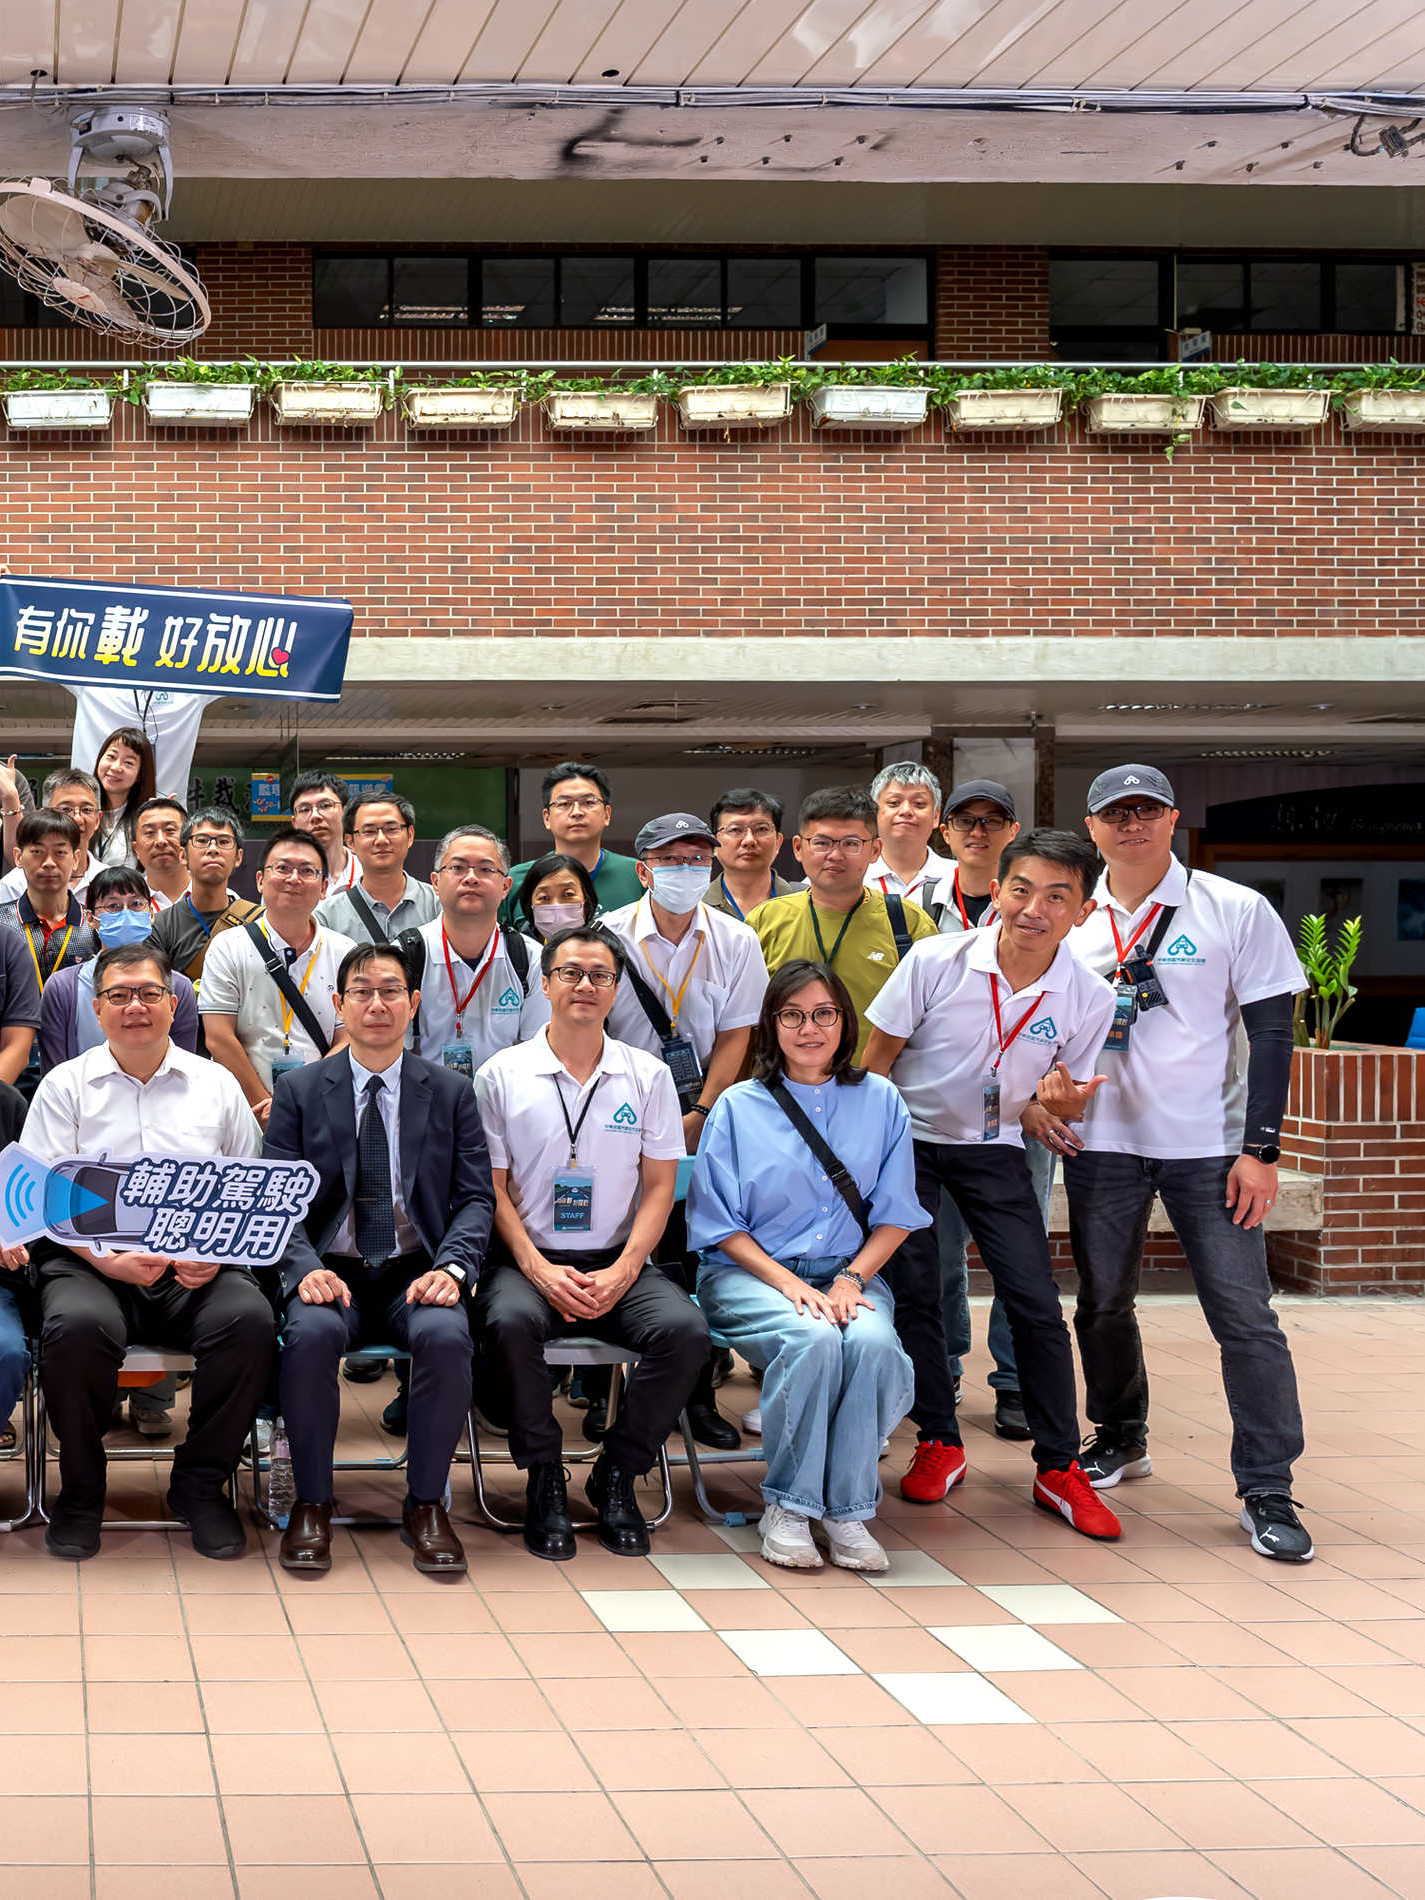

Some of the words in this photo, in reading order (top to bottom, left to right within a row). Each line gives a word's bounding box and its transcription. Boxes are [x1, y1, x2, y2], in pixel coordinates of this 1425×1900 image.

[13, 605, 145, 666] 有你載
[154, 611, 297, 678] 好放心
[123, 1161, 312, 1213] 輔助駕駛
[144, 1208, 290, 1256] 聰明用
